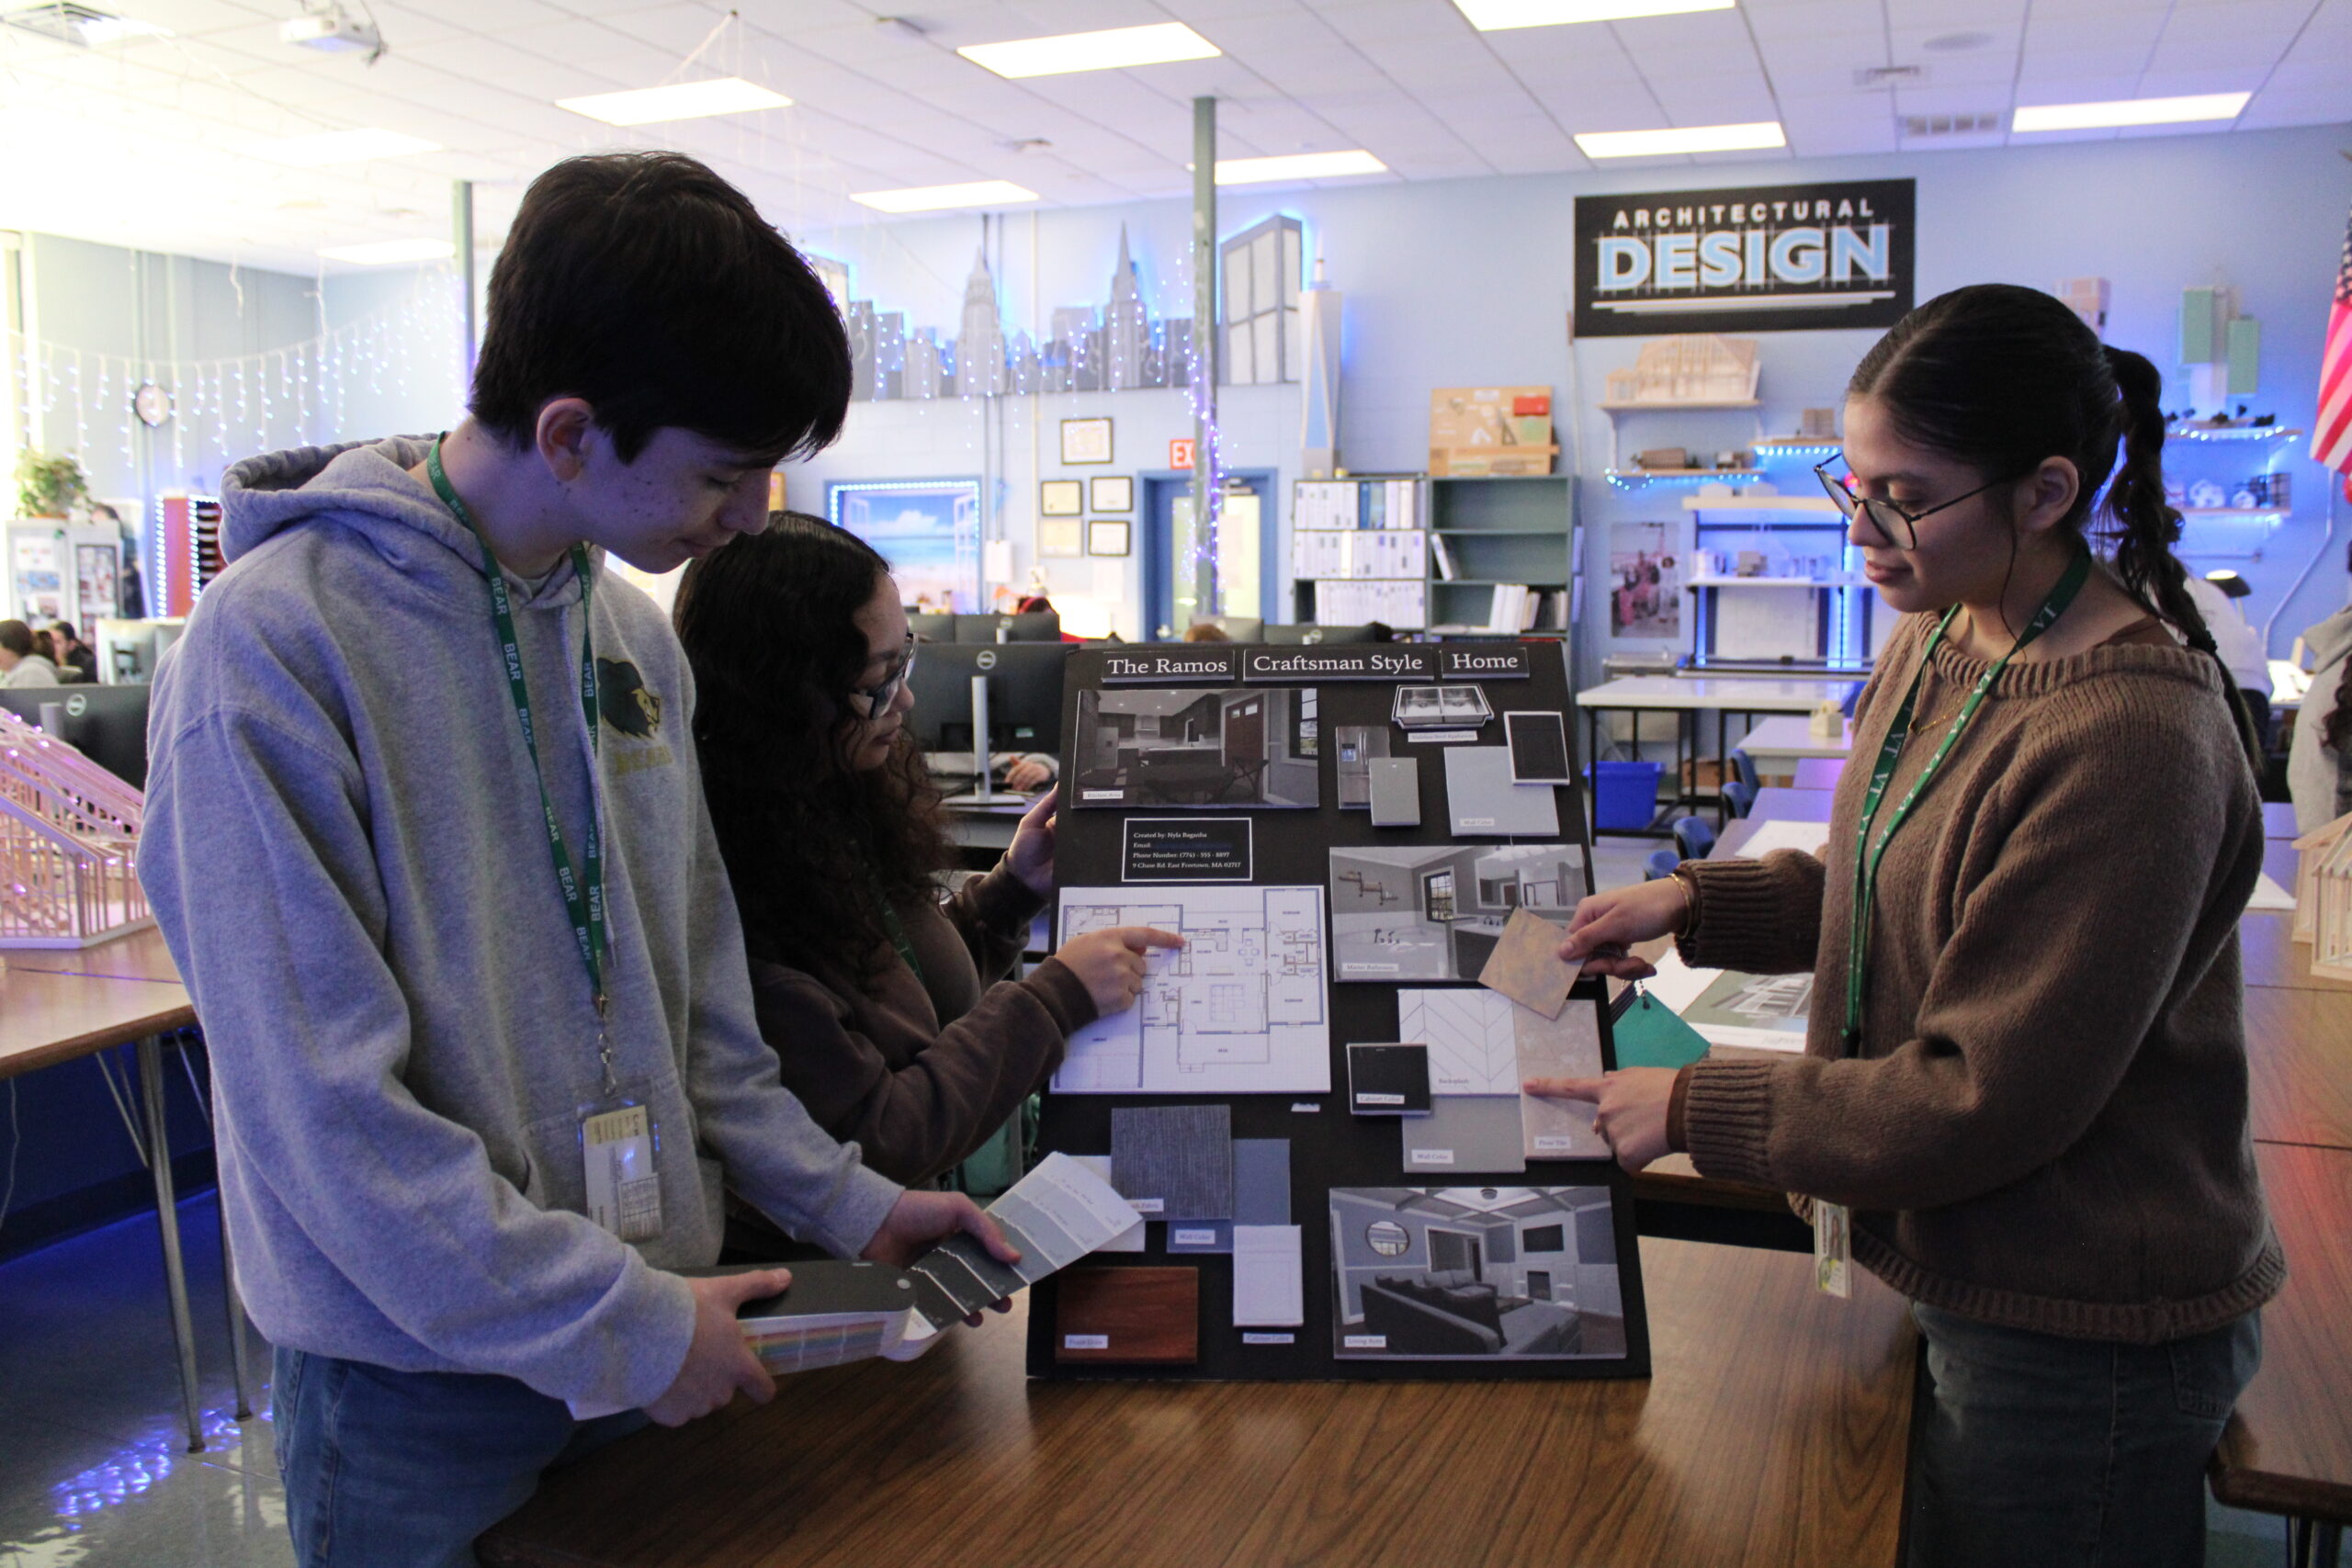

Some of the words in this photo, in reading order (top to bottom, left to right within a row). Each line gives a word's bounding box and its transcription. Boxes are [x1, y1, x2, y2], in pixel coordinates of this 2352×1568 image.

[1613, 197, 1874, 230] ARCHITECTURAL
[1597, 224, 1890, 291] DESIGN
[1173, 443, 1195, 467] EX
[492, 577, 508, 615] BEAR
[503, 642, 522, 681] BEAR
[1107, 659, 1149, 674] The
[1155, 658, 1227, 673] Ramos
[1253, 655, 1364, 671] Craftsman
[1371, 654, 1423, 675] Style
[1452, 654, 1519, 669] Home
[583, 662, 594, 698] BEAR
[519, 708, 533, 745] BEAR
[546, 807, 559, 842] BEAR
[559, 867, 577, 902] BEAR
[589, 886, 602, 921] BEAR
[576, 926, 592, 961] BEAR
